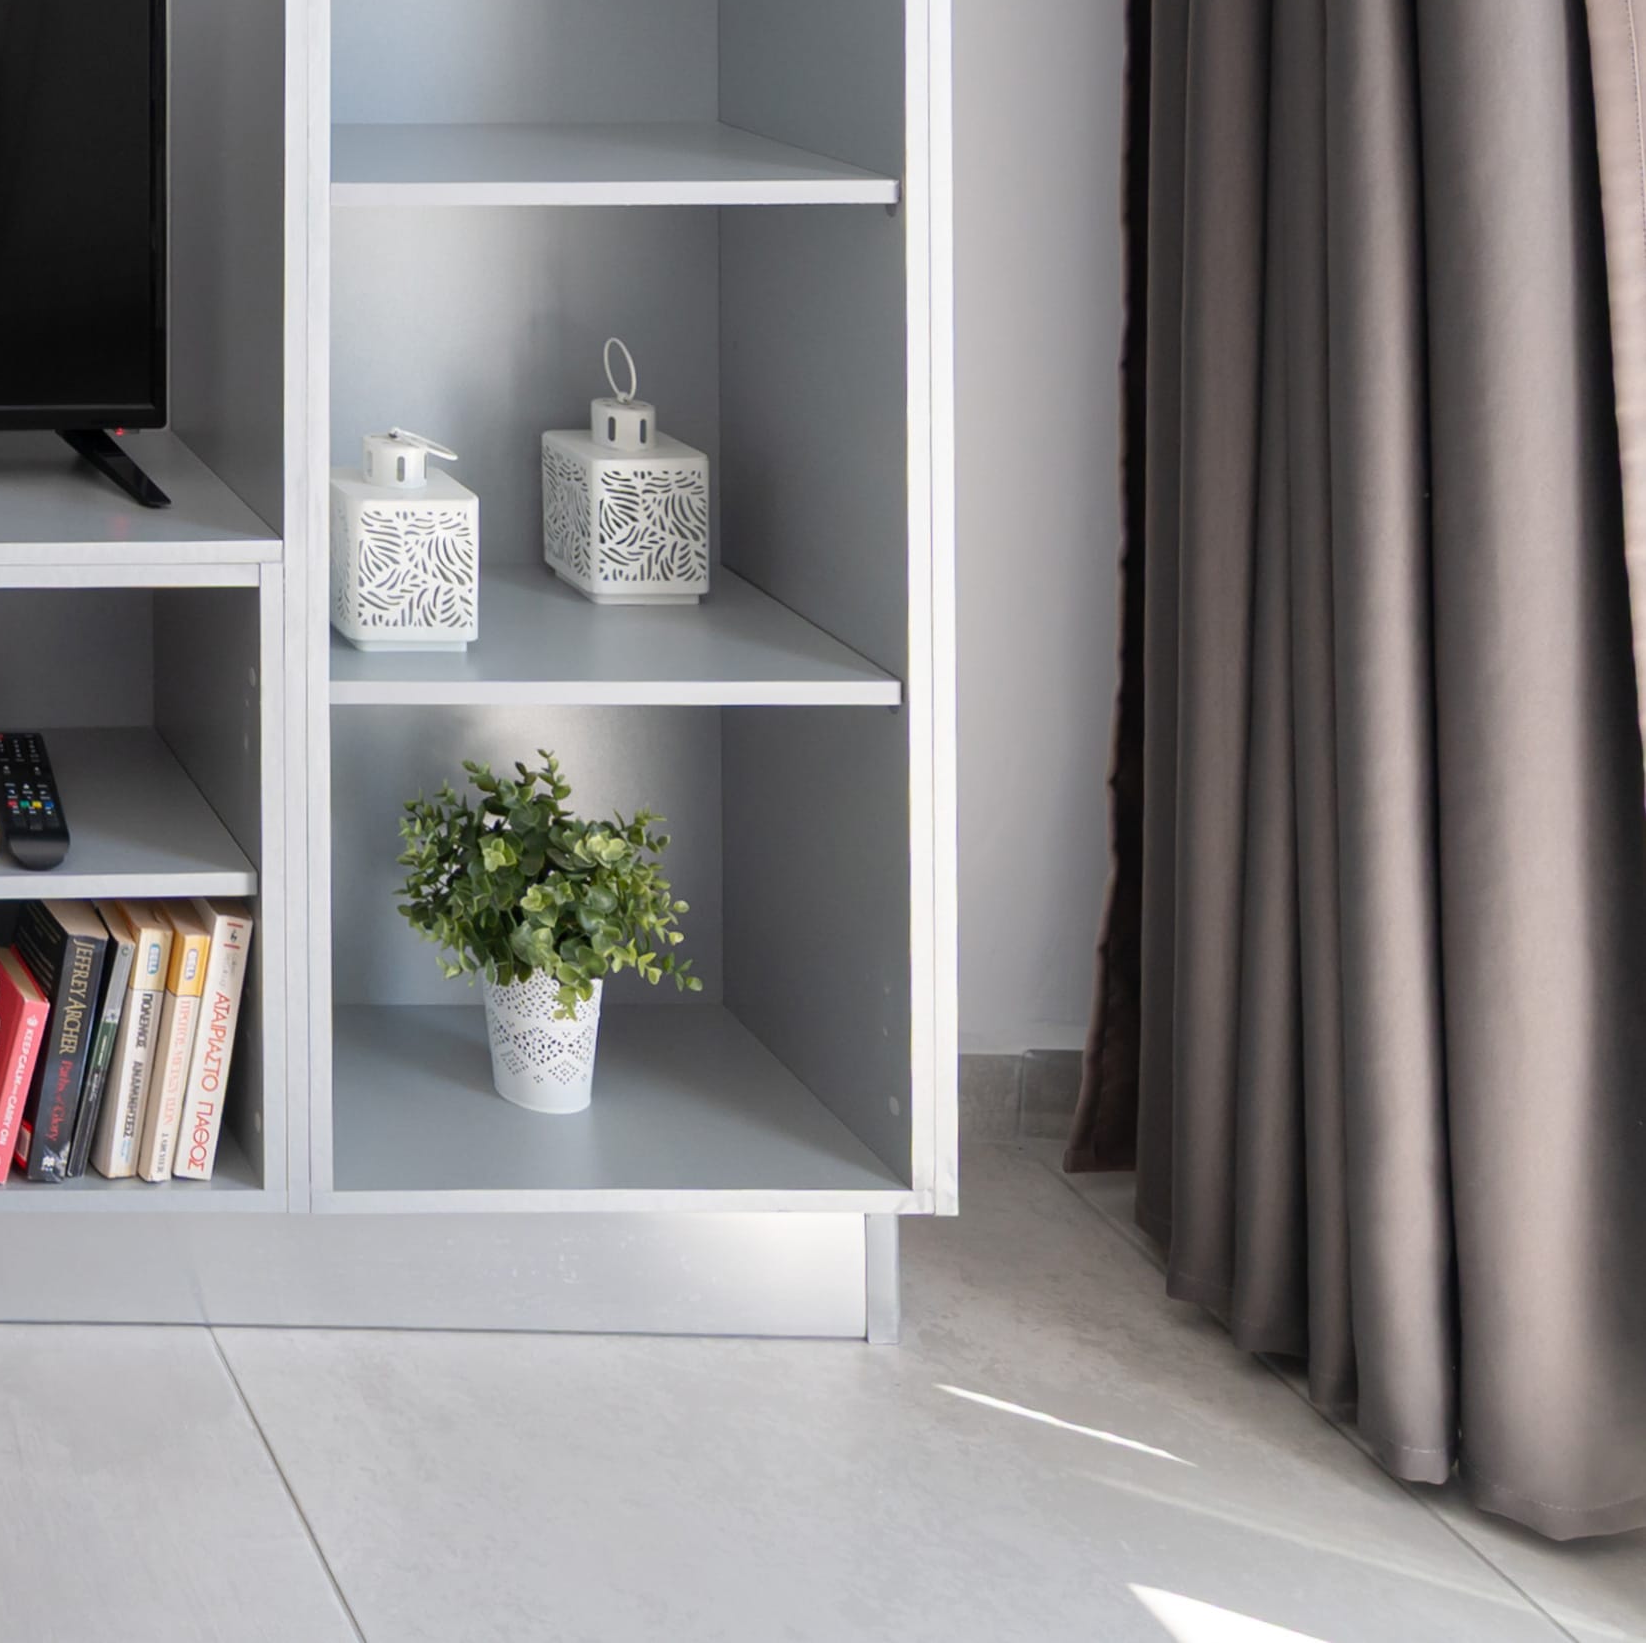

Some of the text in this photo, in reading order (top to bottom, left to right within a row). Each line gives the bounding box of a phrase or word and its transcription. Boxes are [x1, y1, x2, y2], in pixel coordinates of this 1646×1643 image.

[69, 939, 95, 998] JEFFREY
[22, 1028, 34, 1055] KEEP
[59, 997, 87, 1054] ARCHER
[201, 991, 231, 1092] ΑΤΑΙΡΙΑΣΤΟ
[14, 1055, 28, 1086] CALM
[5, 1096, 18, 1129] CARRY
[45, 1104, 66, 1141] Glory
[187, 1101, 214, 1172] ΠΑΘΟΣ
